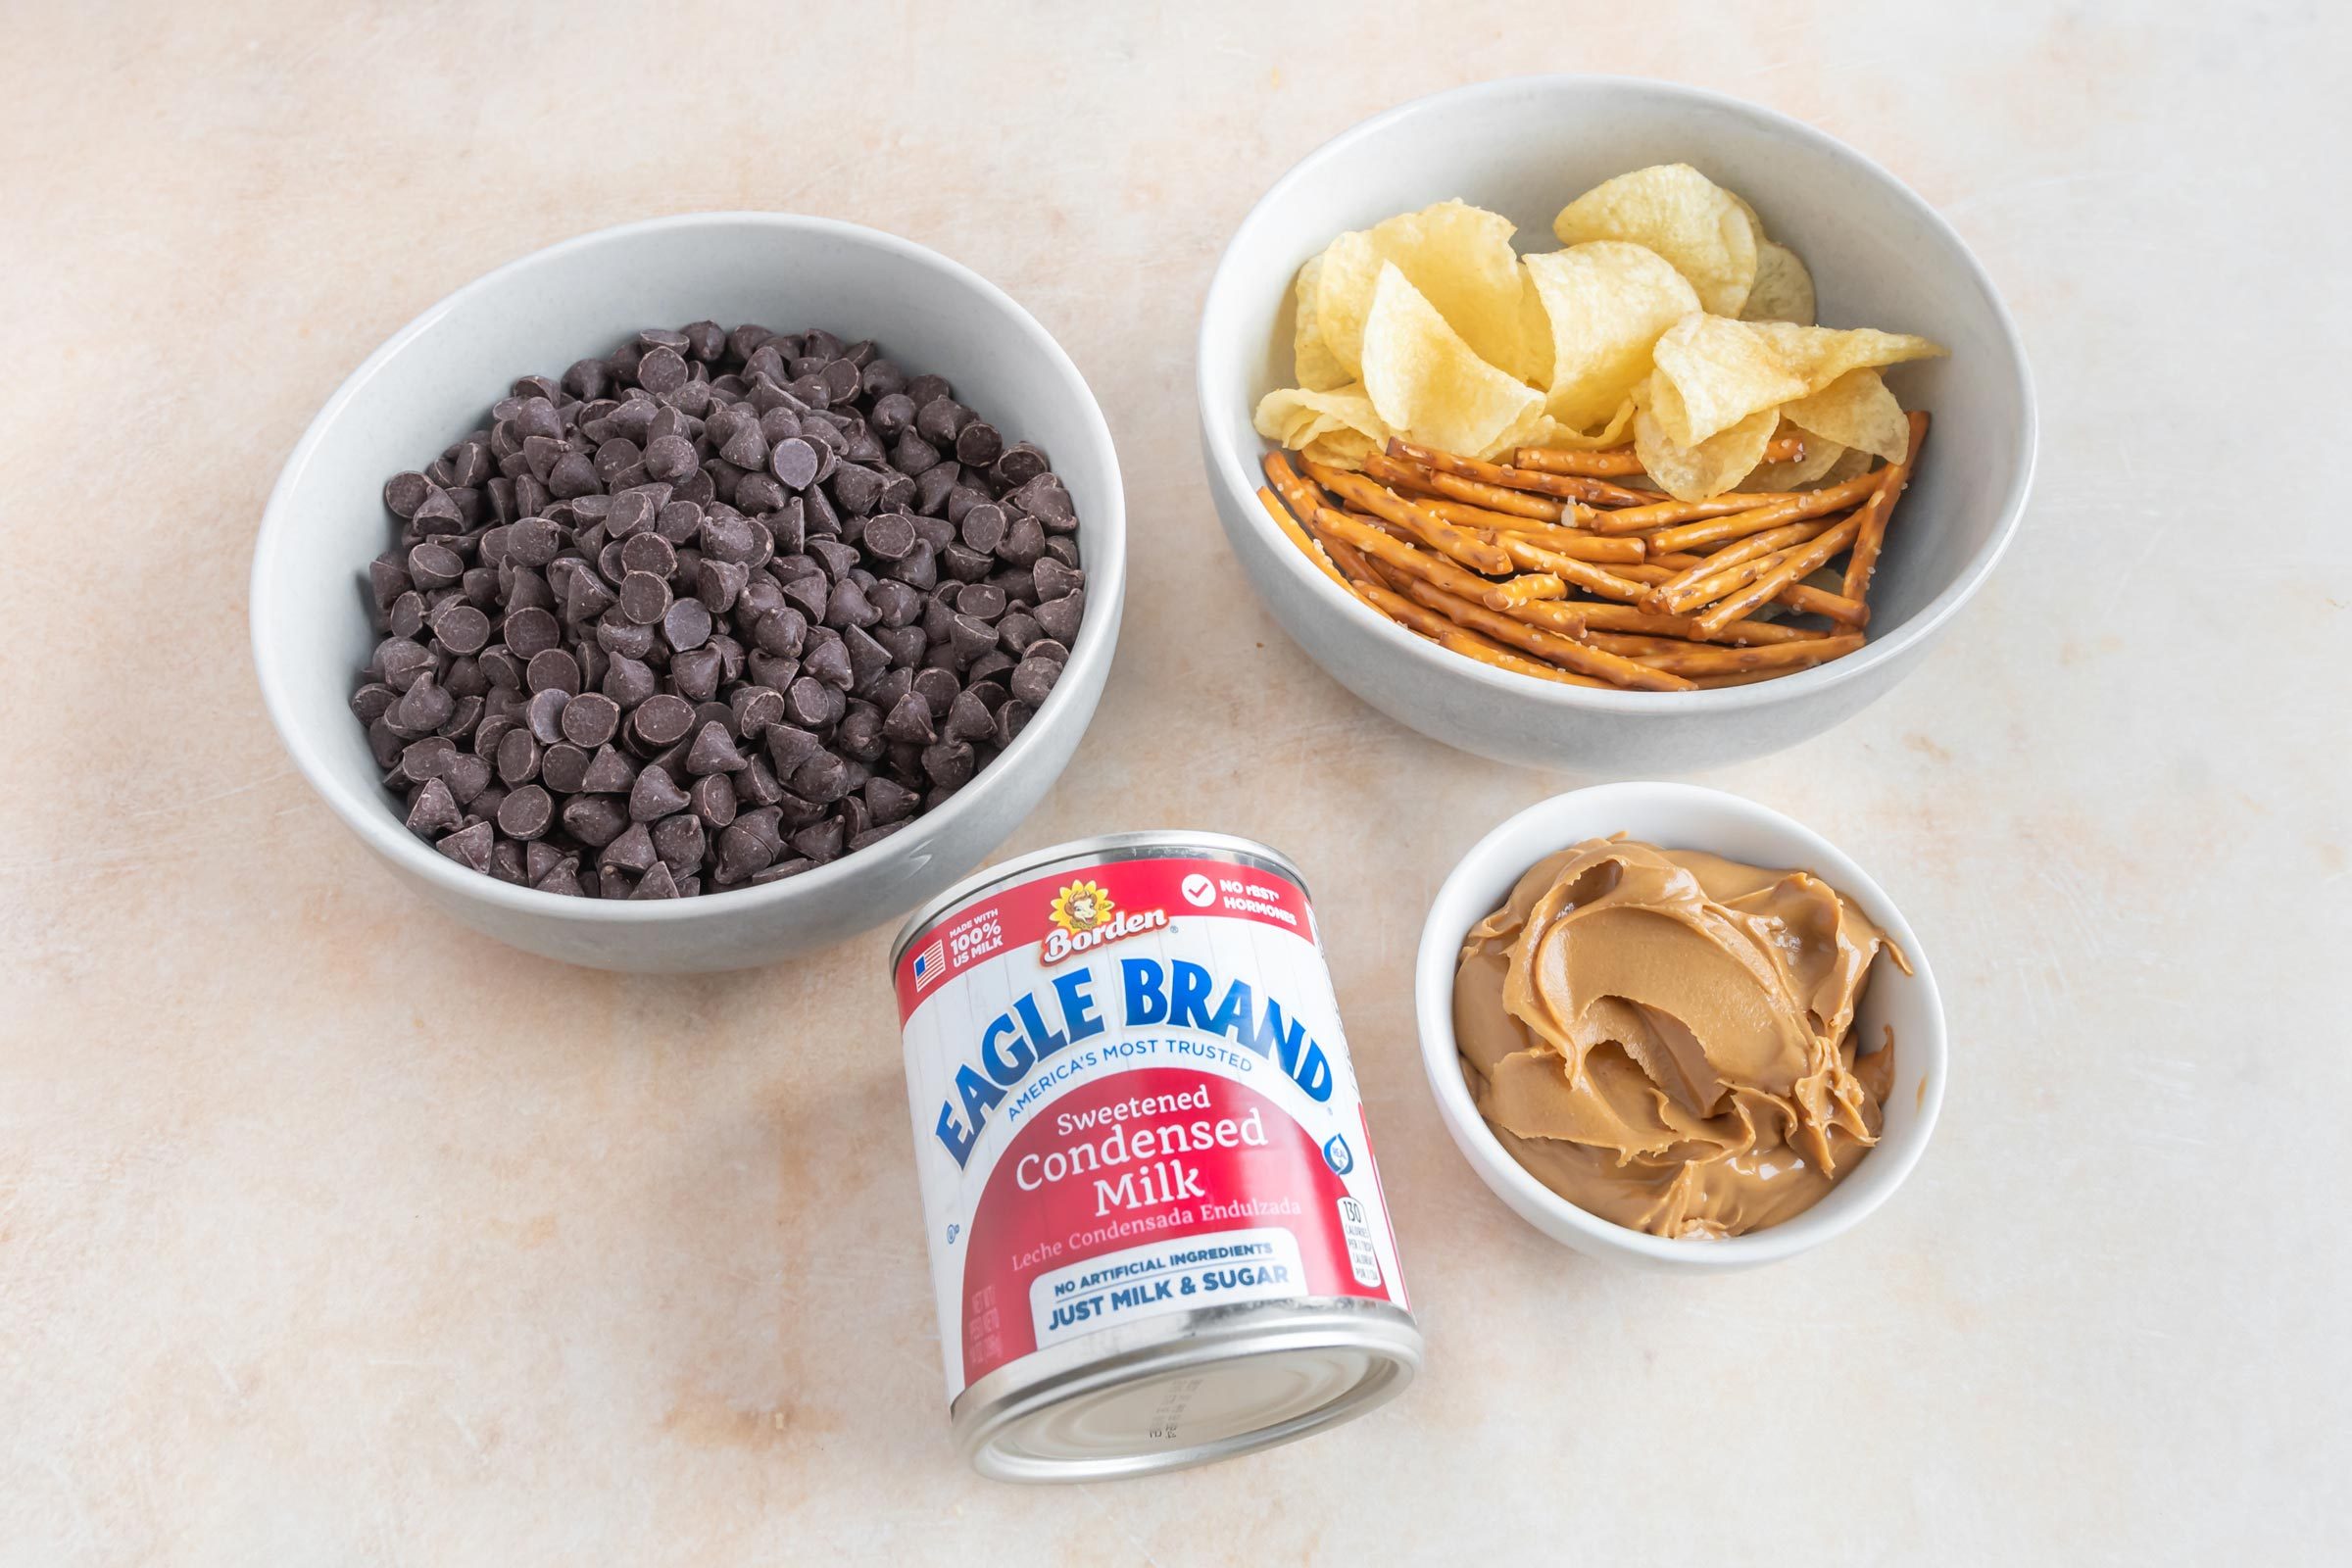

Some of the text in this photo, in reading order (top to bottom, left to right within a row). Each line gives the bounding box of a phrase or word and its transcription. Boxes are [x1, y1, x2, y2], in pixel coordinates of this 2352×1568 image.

[1220, 879, 1243, 894] NO
[1223, 896, 1297, 925] HORMONES
[950, 908, 998, 938] MADE WITH
[951, 919, 1001, 956] 100%
[1044, 909, 1167, 962] Borden
[954, 935, 1003, 967] US MILK
[935, 966, 1104, 1170] EAGLE
[1121, 957, 1333, 1102] BRAND
[1007, 1039, 1252, 1121] AMERICA'S MOST TRUSTED
[1056, 1084, 1211, 1136] Sweetened
[1016, 1107, 1268, 1191] Condensed
[1094, 1159, 1205, 1217] Milk
[1343, 1200, 1361, 1223] 130
[1011, 1198, 1301, 1272] Leche Condensada Endulzada
[1054, 1243, 1273, 1297] NO ARTIFICIAL INGREDIENTS
[1049, 1265, 1289, 1331] JUST MILK & SUGAR
